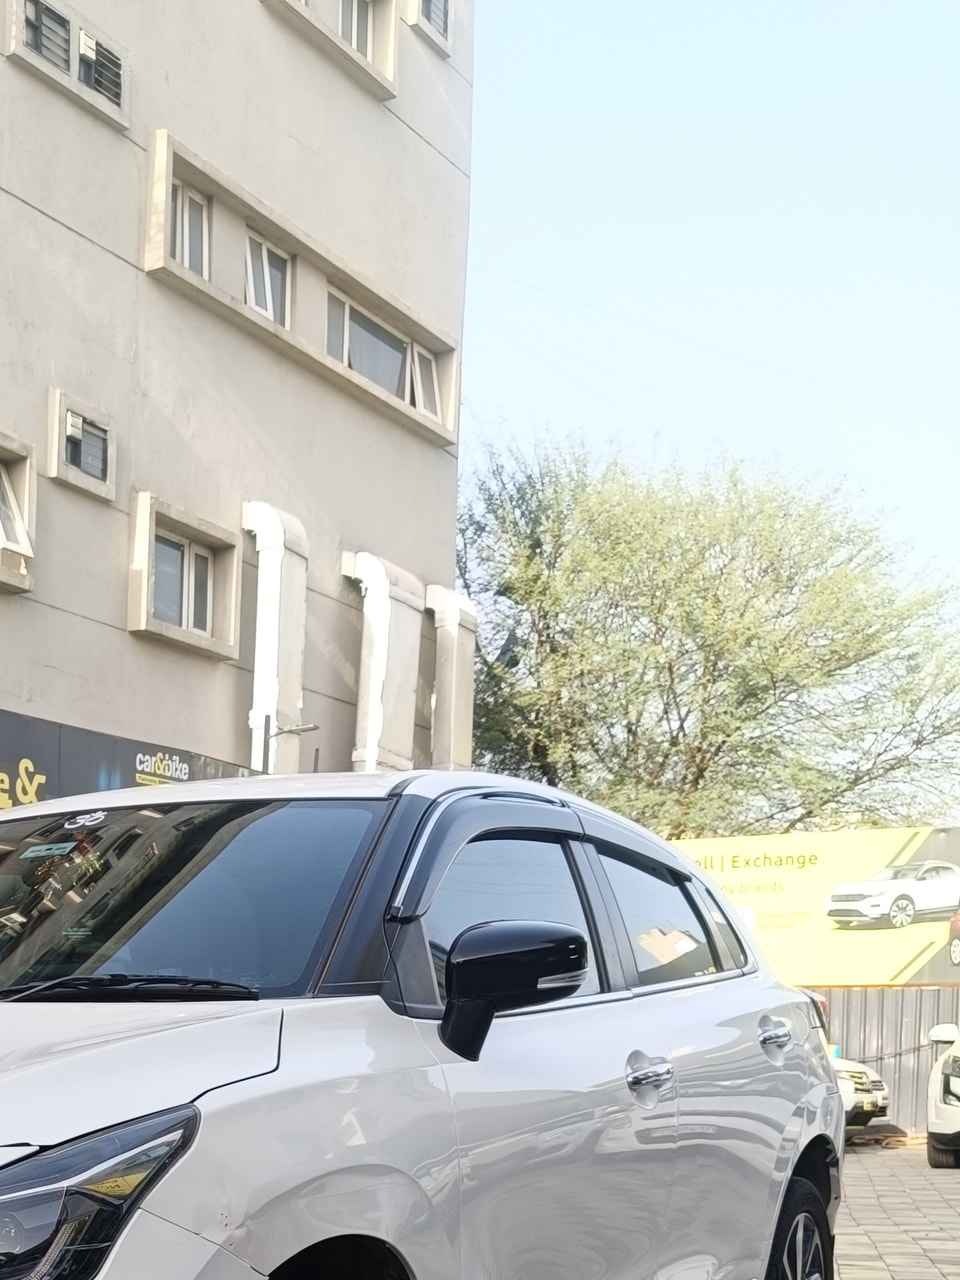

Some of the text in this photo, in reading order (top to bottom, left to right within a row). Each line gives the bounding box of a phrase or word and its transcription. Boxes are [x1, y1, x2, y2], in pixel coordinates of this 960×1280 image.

[15, 758, 47, 804] &
[135, 751, 190, 781] car&bike
[731, 852, 819, 869] Exchange
